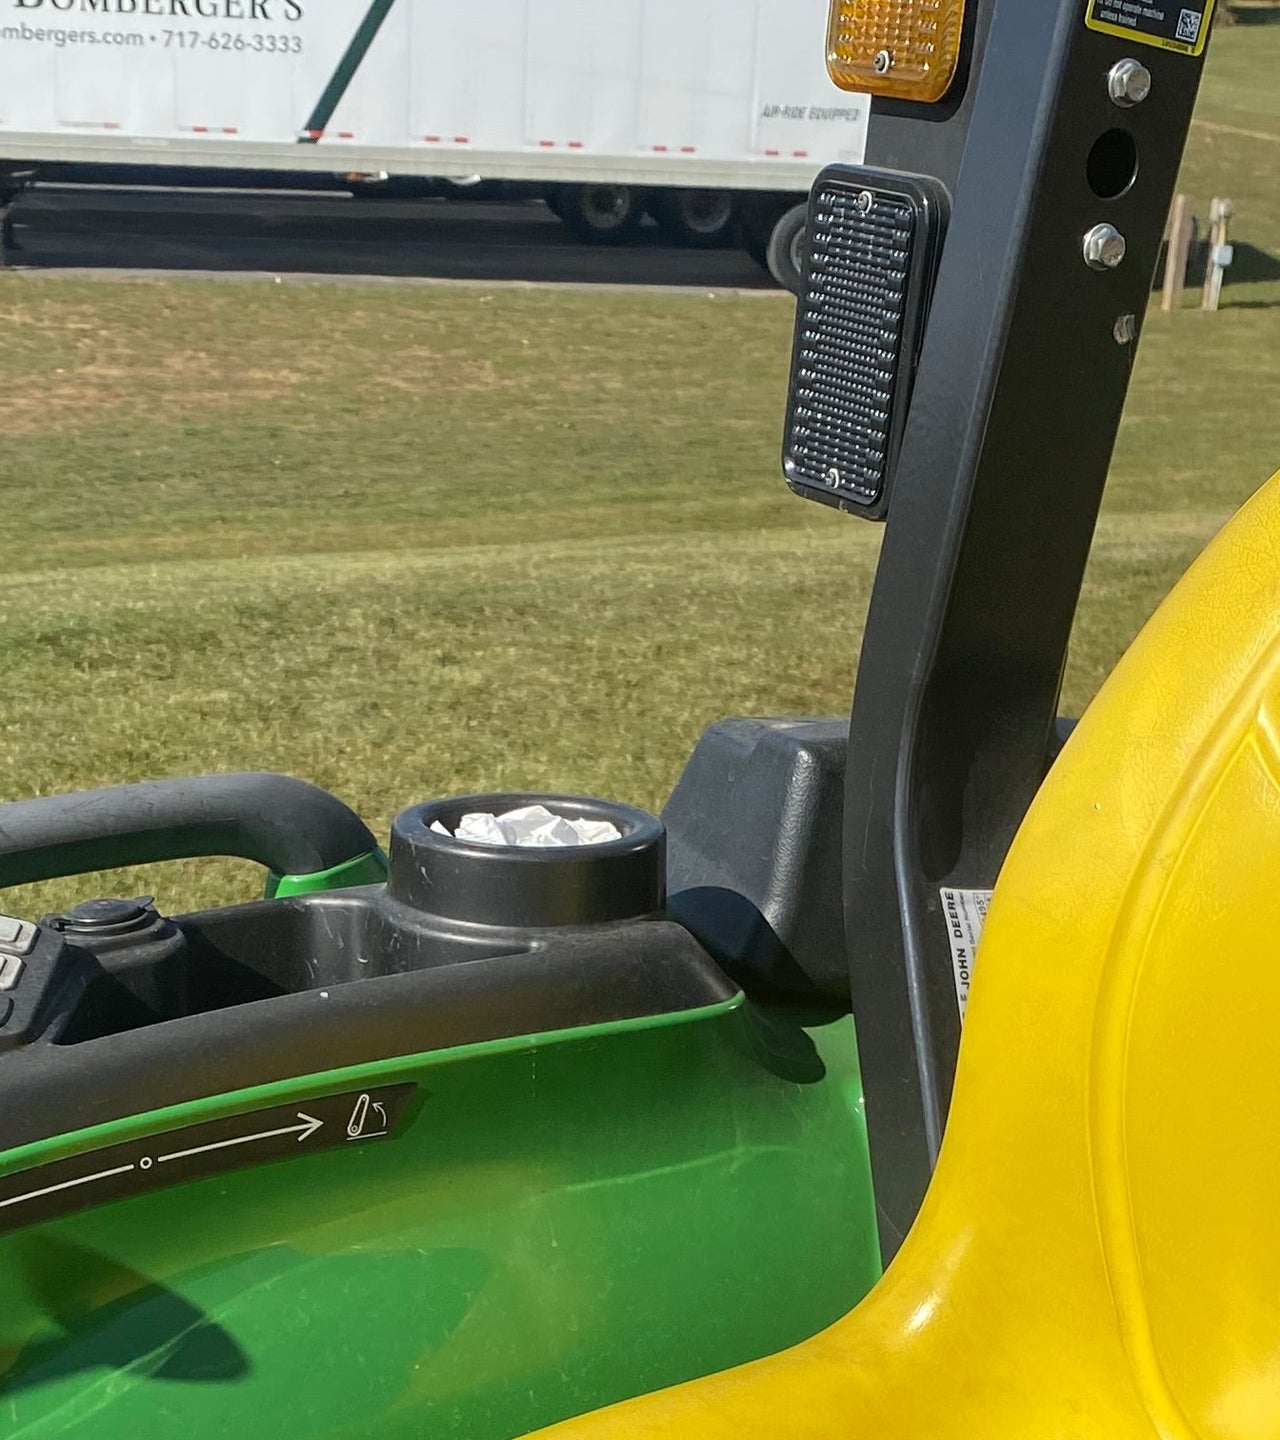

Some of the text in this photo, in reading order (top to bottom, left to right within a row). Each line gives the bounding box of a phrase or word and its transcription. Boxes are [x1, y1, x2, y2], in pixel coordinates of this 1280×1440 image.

[162, 29, 302, 53] 717-626-3333
[945, 892, 963, 938] DEERE
[956, 948, 970, 990] JOHN
